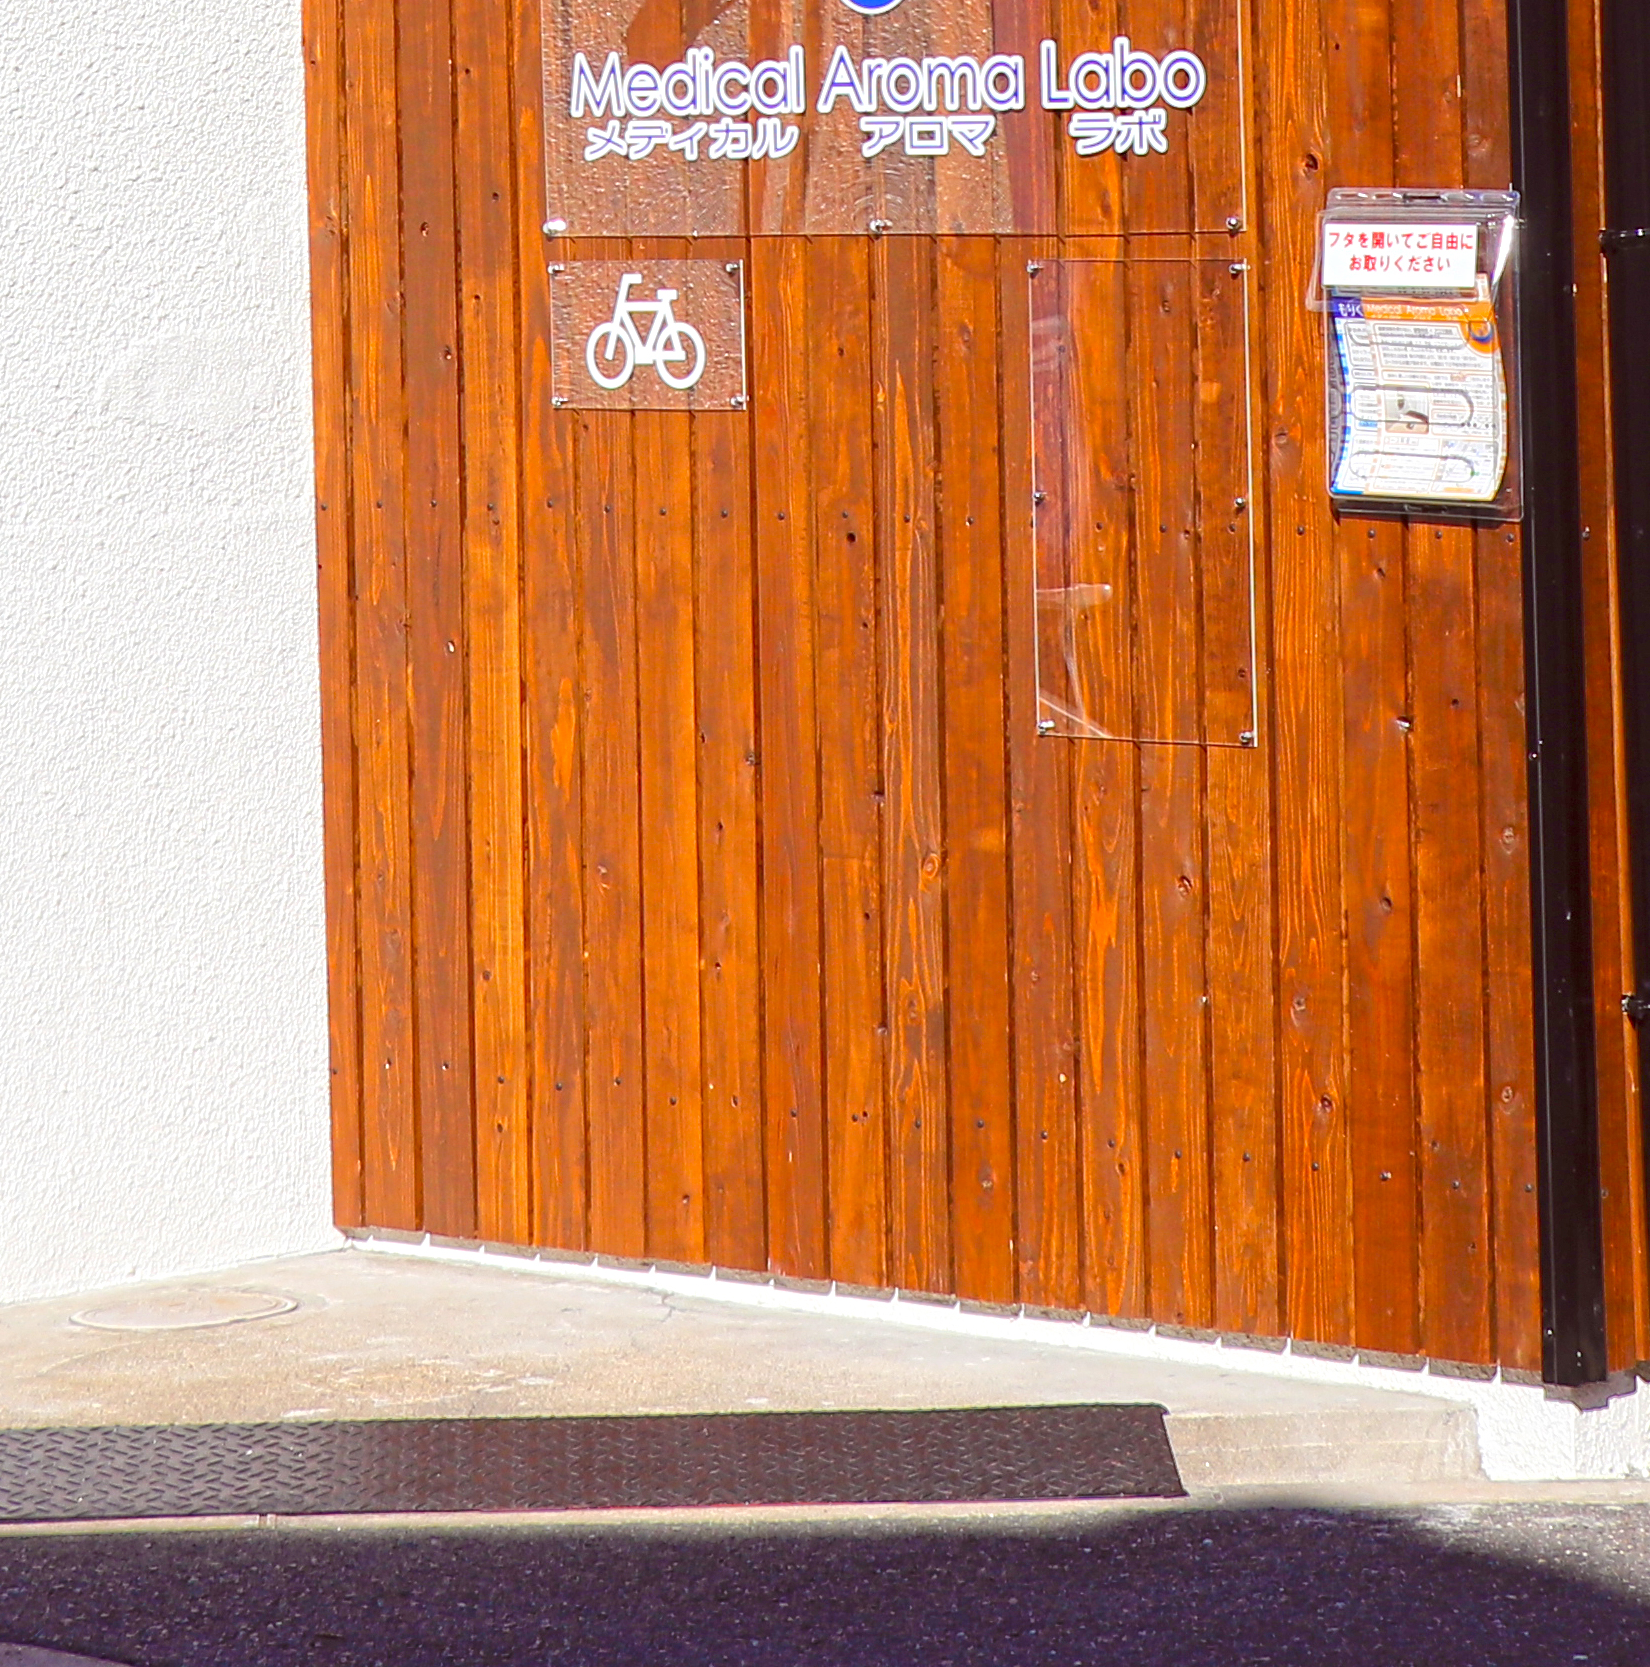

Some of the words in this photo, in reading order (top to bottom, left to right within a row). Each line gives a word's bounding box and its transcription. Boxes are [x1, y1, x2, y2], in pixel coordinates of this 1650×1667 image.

[570, 44, 805, 118] Medical
[817, 45, 1024, 115] Aroma
[1040, 37, 1207, 113] Labo
[584, 118, 799, 161] メディカル
[860, 114, 997, 157] アロマ
[1068, 112, 1169, 155] ラボ
[1329, 231, 1474, 250] フタを開いてご自由に
[1349, 254, 1451, 272] お取りください
